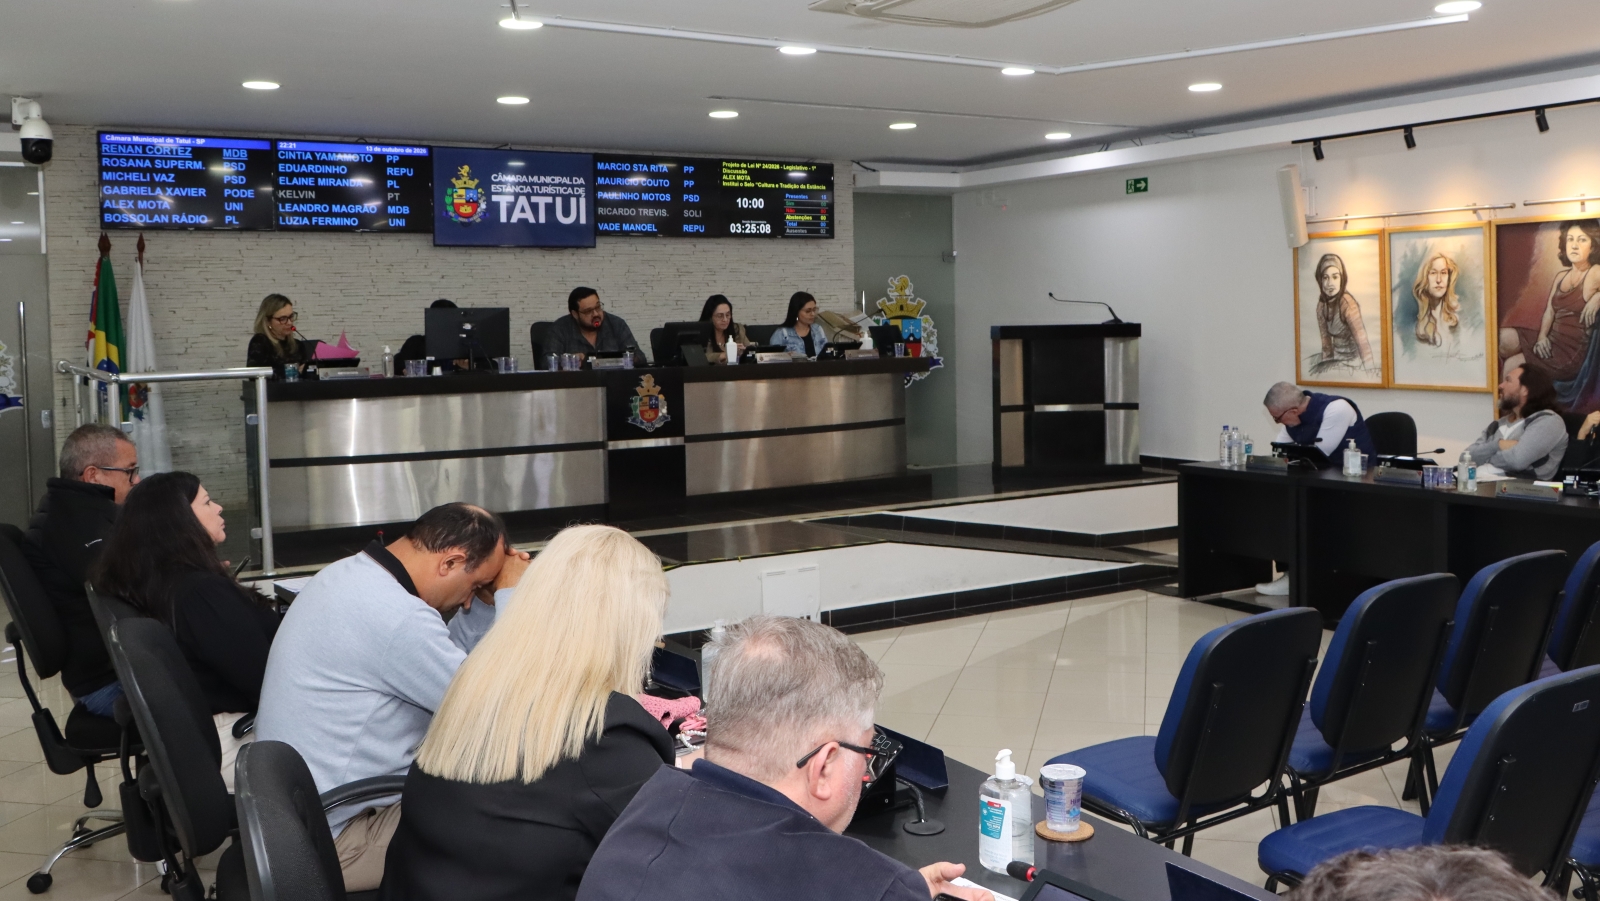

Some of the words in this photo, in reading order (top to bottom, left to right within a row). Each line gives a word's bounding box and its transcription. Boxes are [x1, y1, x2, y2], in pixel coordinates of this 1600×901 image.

[133, 135, 164, 144] Municipal
[102, 144, 142, 154] RENAN
[146, 146, 192, 156] CORTEZ
[223, 149, 247, 158] MDB
[278, 151, 312, 160] CINTIA
[315, 152, 373, 162] YAMAMOTO
[102, 158, 152, 168] ROSANA
[155, 160, 205, 170] SUPERM.
[224, 162, 245, 171] PSD
[278, 164, 347, 174] EDUARDINHO
[387, 168, 413, 176] REPU
[598, 162, 630, 171] MARCIO
[633, 164, 648, 172] STA
[103, 172, 149, 181] MICHELI
[153, 173, 175, 182] VAZ
[224, 176, 246, 184] PSD
[279, 177, 315, 185] ELAINE
[318, 178, 363, 187] MIRANDA
[491, 172, 528, 182] CÂMARA
[529, 176, 572, 184] MUNICIPAL
[598, 177, 639, 186] MAURICIO
[641, 178, 670, 186] COUTO
[103, 186, 162, 196] GABRIELA
[166, 187, 206, 197] XAVIER
[224, 189, 254, 198] PODE
[279, 190, 315, 198] KELVIN
[492, 183, 532, 193] ESTÂNCIA
[533, 184, 573, 194] TURÍSTICA
[598, 192, 639, 200] PAULINHO
[104, 200, 134, 208] ALEX
[138, 201, 170, 209] MOTA
[225, 202, 243, 211] UNI
[279, 204, 329, 212] LEANDRO
[737, 198, 764, 208] 10:00
[492, 194, 586, 224] TATUÍ
[104, 214, 169, 223] BOSSOLAN
[172, 213, 208, 223] RÁDIO
[225, 216, 239, 224] PL
[279, 216, 309, 225] LUZIA
[312, 217, 358, 226] FERMINO
[730, 223, 771, 233] 03:25:08
